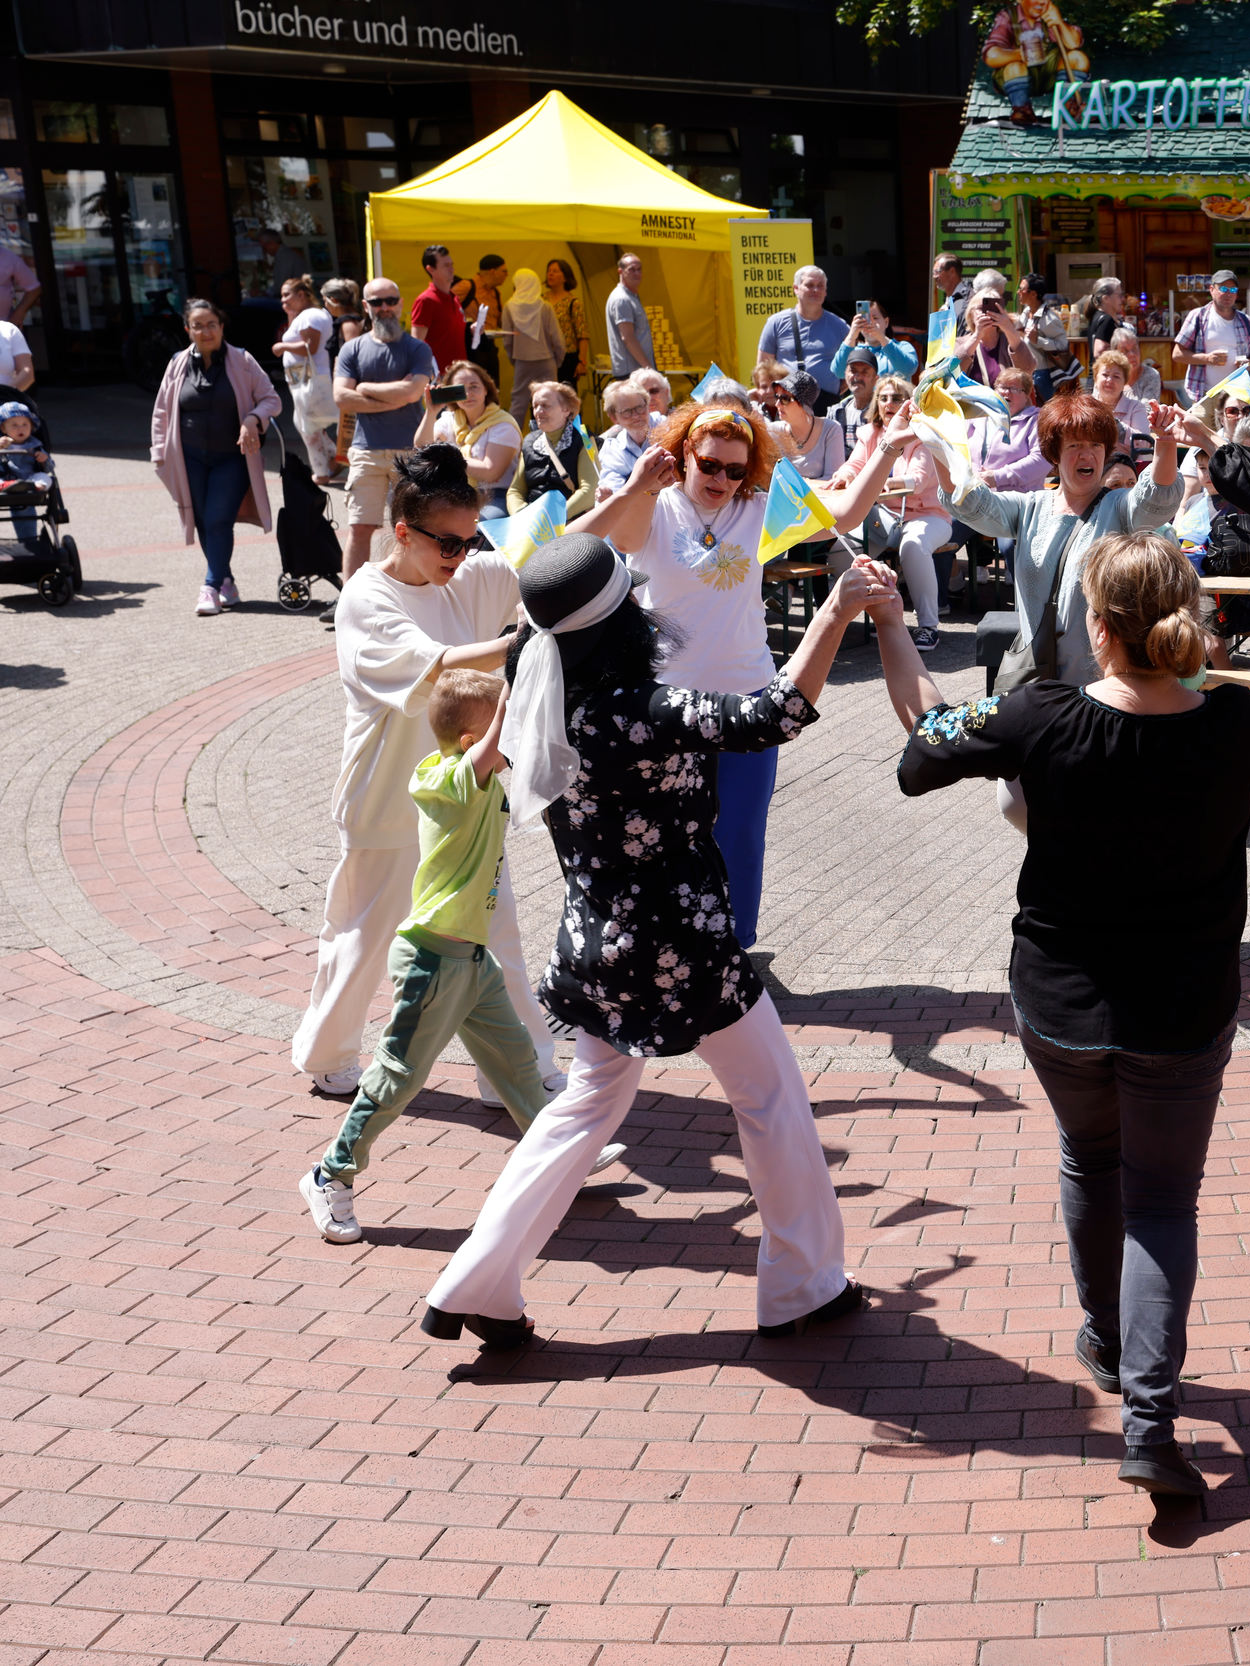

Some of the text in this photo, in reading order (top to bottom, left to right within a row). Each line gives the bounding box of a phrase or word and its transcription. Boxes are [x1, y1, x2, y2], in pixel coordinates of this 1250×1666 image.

[235, 0, 524, 56] bücher und medien.
[641, 214, 696, 231] AMNESTY
[641, 229, 697, 241] INTERNATIONAL
[741, 235, 769, 248] BITTE
[742, 252, 797, 265] EINTRETEN
[744, 267, 784, 281] FÜR DIE
